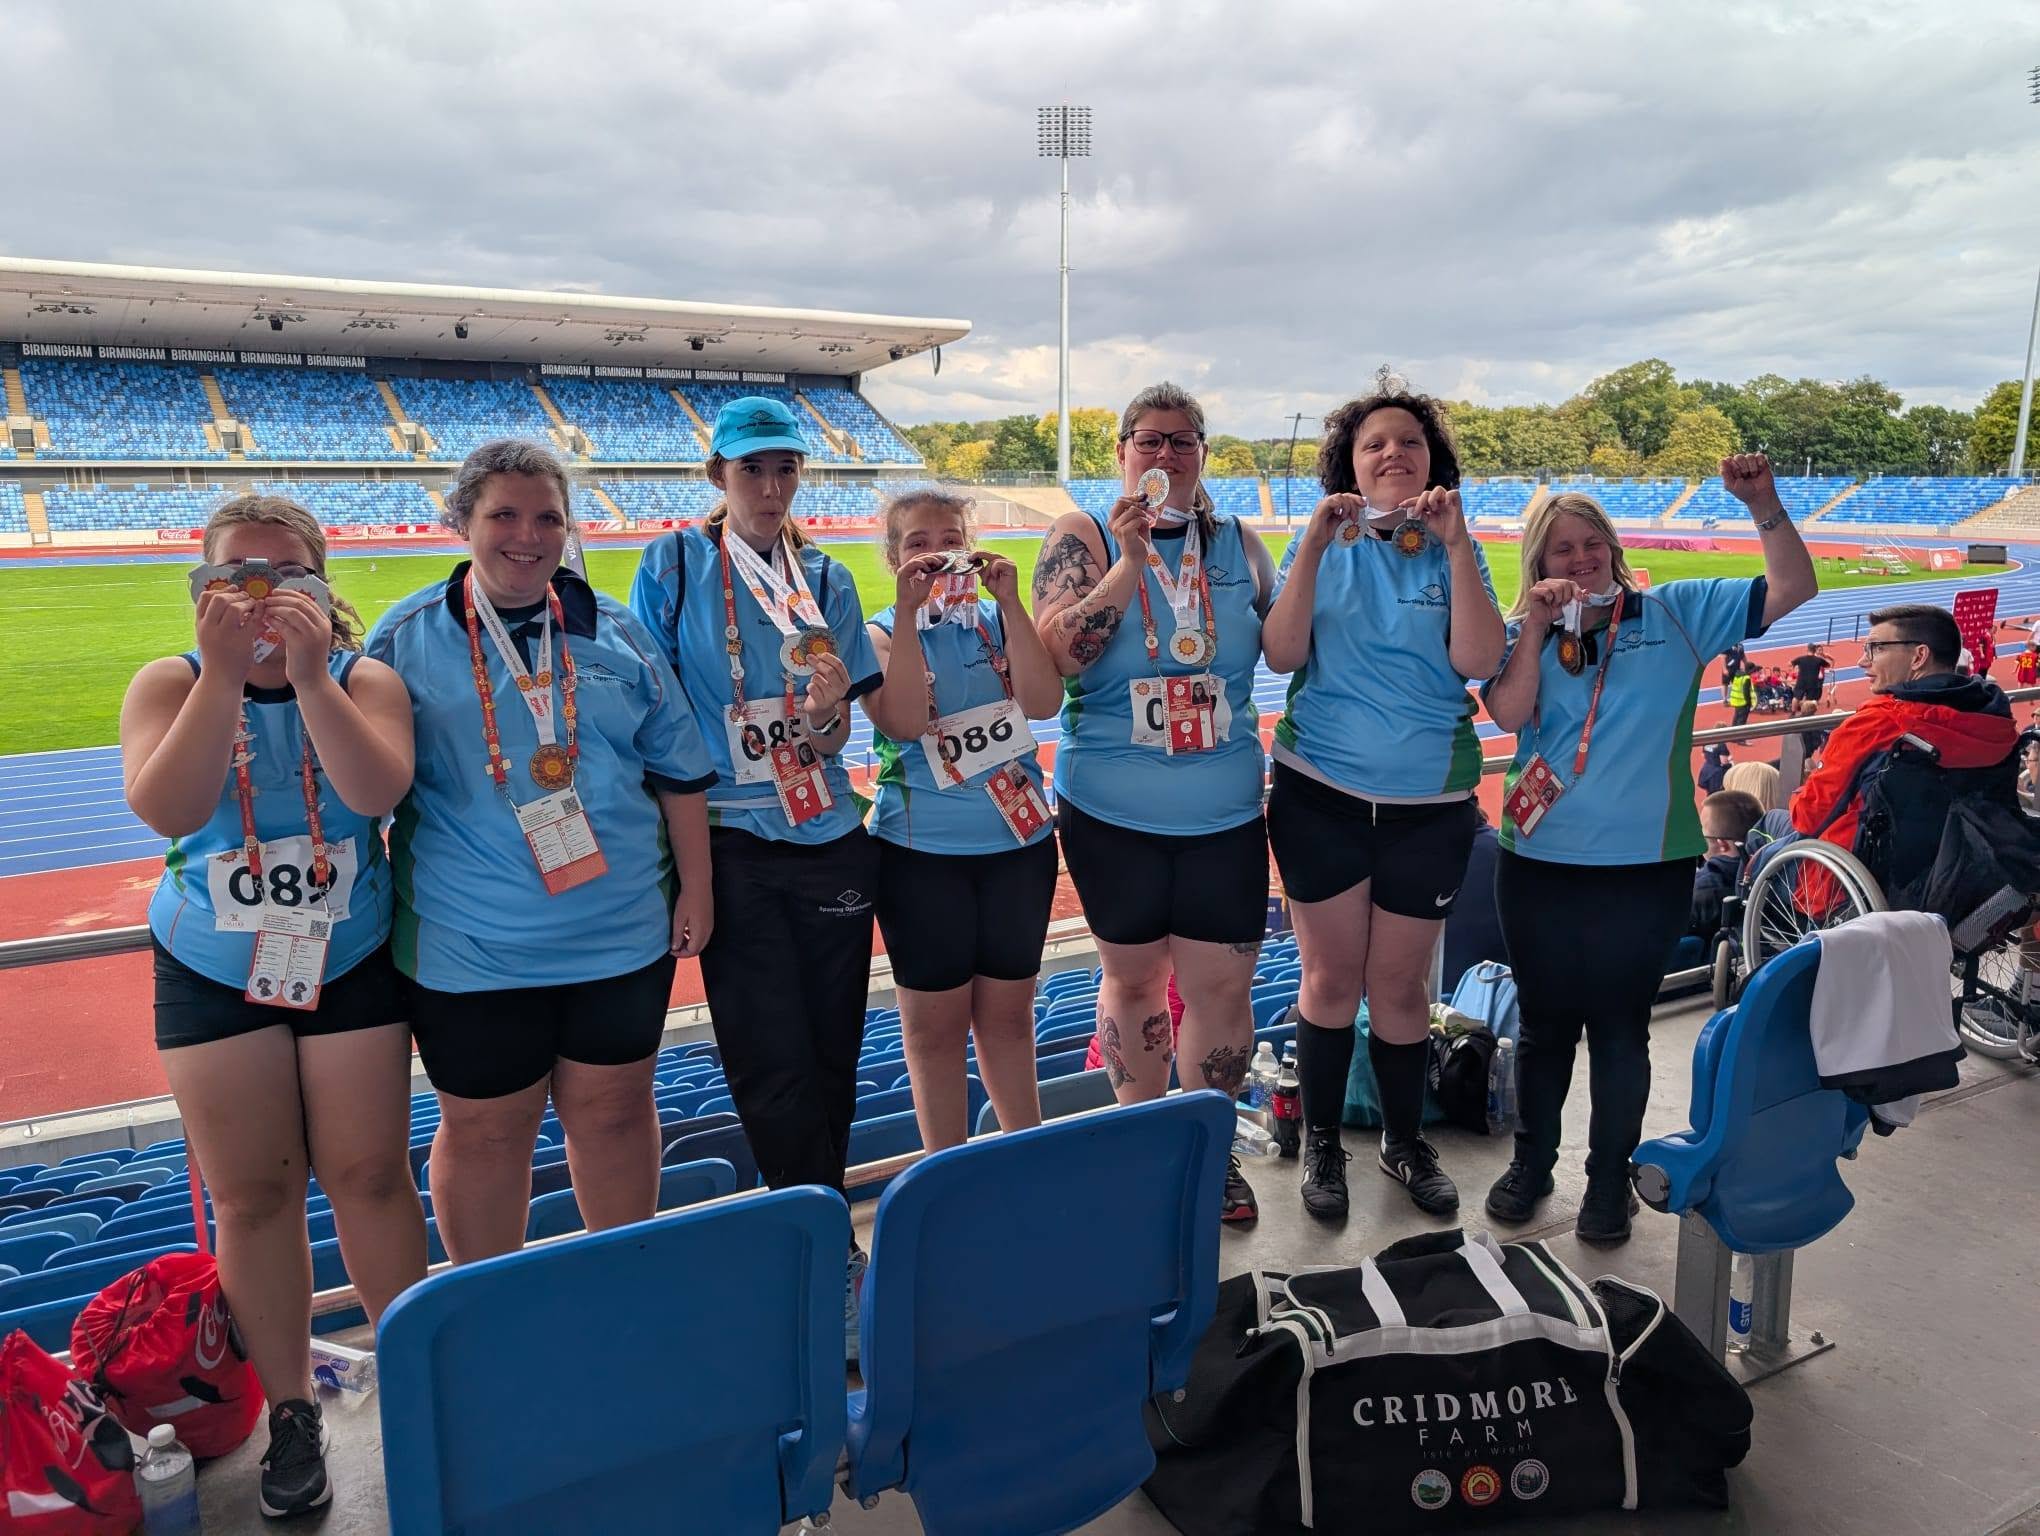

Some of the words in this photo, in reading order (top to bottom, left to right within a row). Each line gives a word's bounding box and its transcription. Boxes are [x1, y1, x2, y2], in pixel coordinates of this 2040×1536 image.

[22, 343, 93, 358] BIRMINGHAM
[99, 346, 166, 360] BIRMINGHAM
[171, 349, 235, 363] BIRMINGHAM
[240, 351, 302, 366] BIRMINGHAM
[307, 354, 367, 368] BIRMINGHAM
[541, 364, 591, 376] BIRMINGHAM
[594, 366, 643, 378] BIRMINGHAM
[646, 368, 692, 379] BIRMINGHAM
[695, 370, 740, 381] BIRMINGHAM
[742, 372, 786, 383] BIRMINGHAM
[1397, 598, 1425, 606] Sporting
[937, 716, 1014, 764] 086
[1184, 735, 1192, 743] A
[803, 800, 811, 810] A
[1352, 1377, 1578, 1426] CRIDMORE
[1419, 1418, 1533, 1446] FARM
